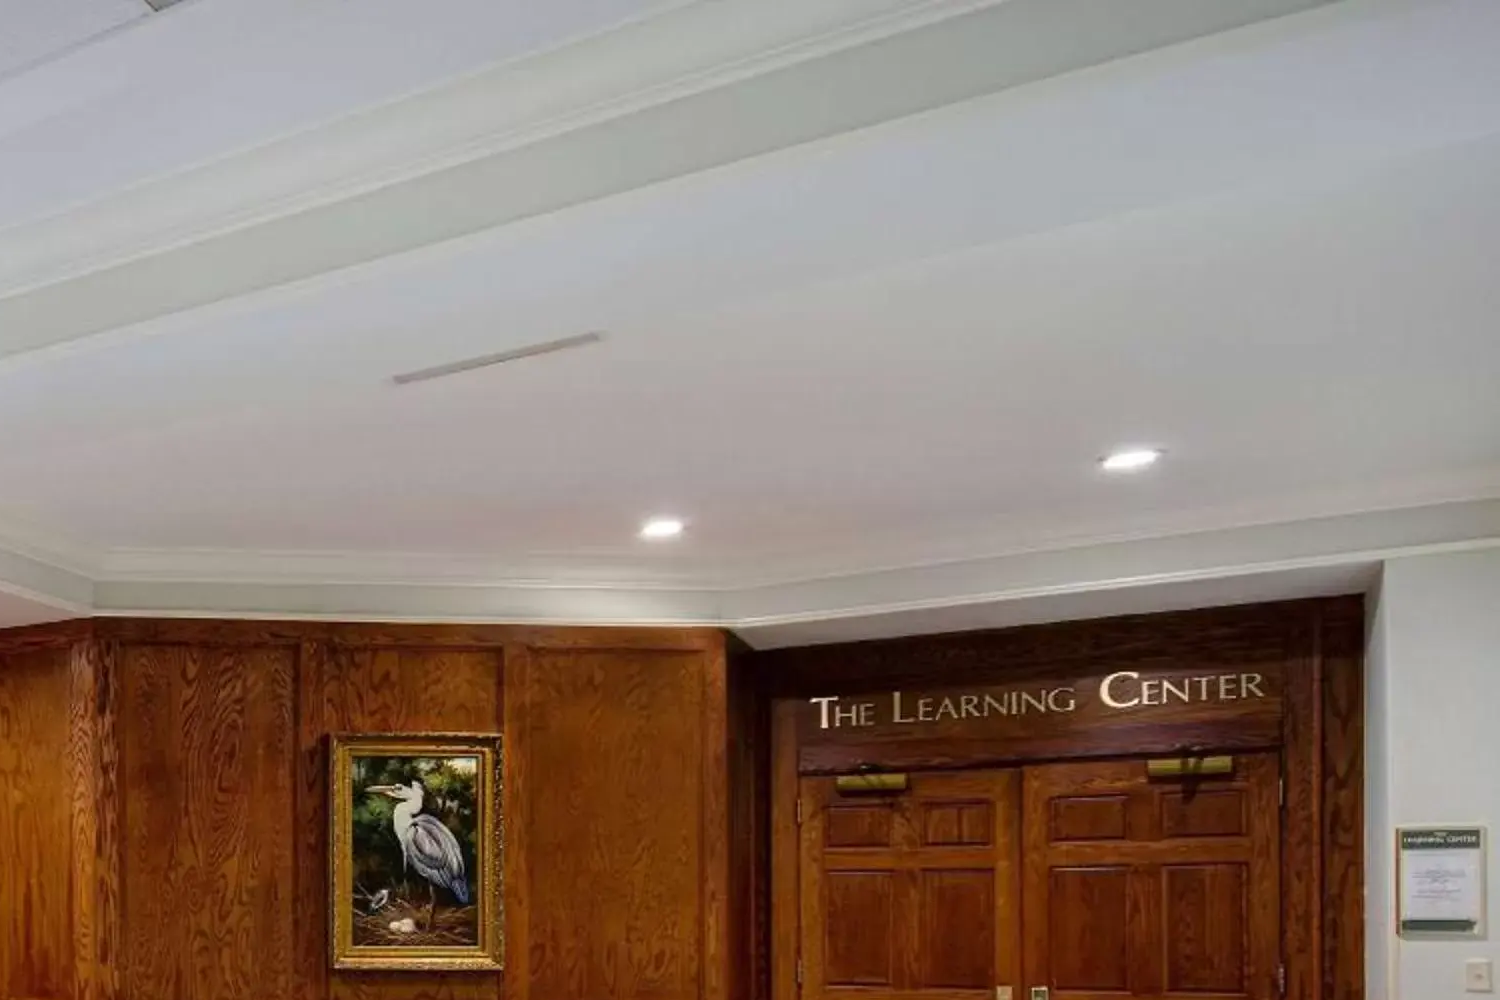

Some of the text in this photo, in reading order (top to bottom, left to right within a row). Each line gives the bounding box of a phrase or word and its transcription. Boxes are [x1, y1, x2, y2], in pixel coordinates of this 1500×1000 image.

[809, 671, 1265, 729] THE LEARNING CENTER
